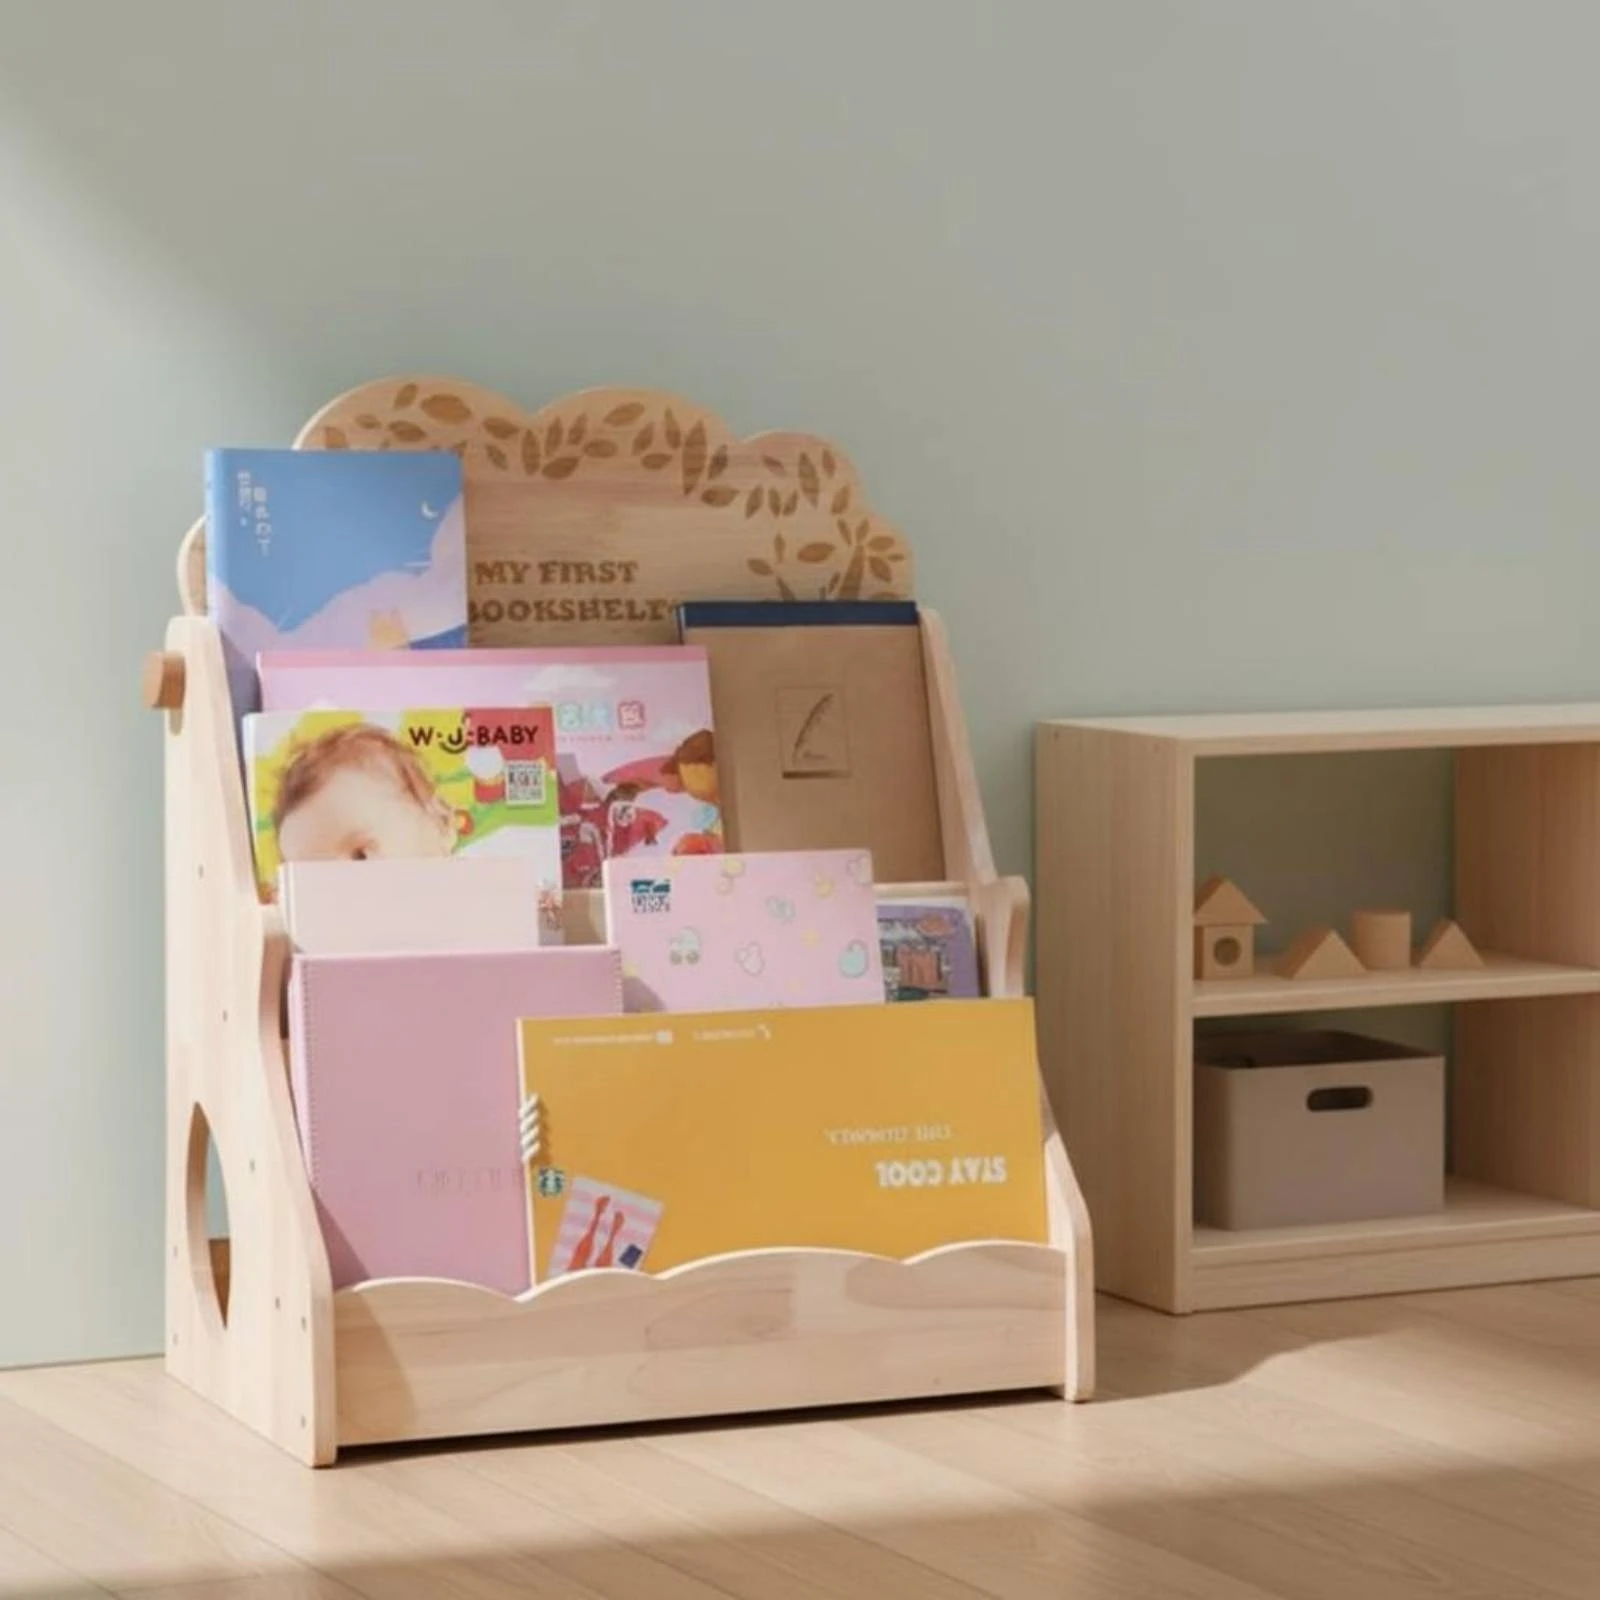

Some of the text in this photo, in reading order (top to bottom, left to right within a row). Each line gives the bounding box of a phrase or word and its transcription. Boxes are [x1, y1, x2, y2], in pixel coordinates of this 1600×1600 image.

[475, 560, 638, 585] MY FIRST
[876, 1156, 1007, 1187] STAY COOL
